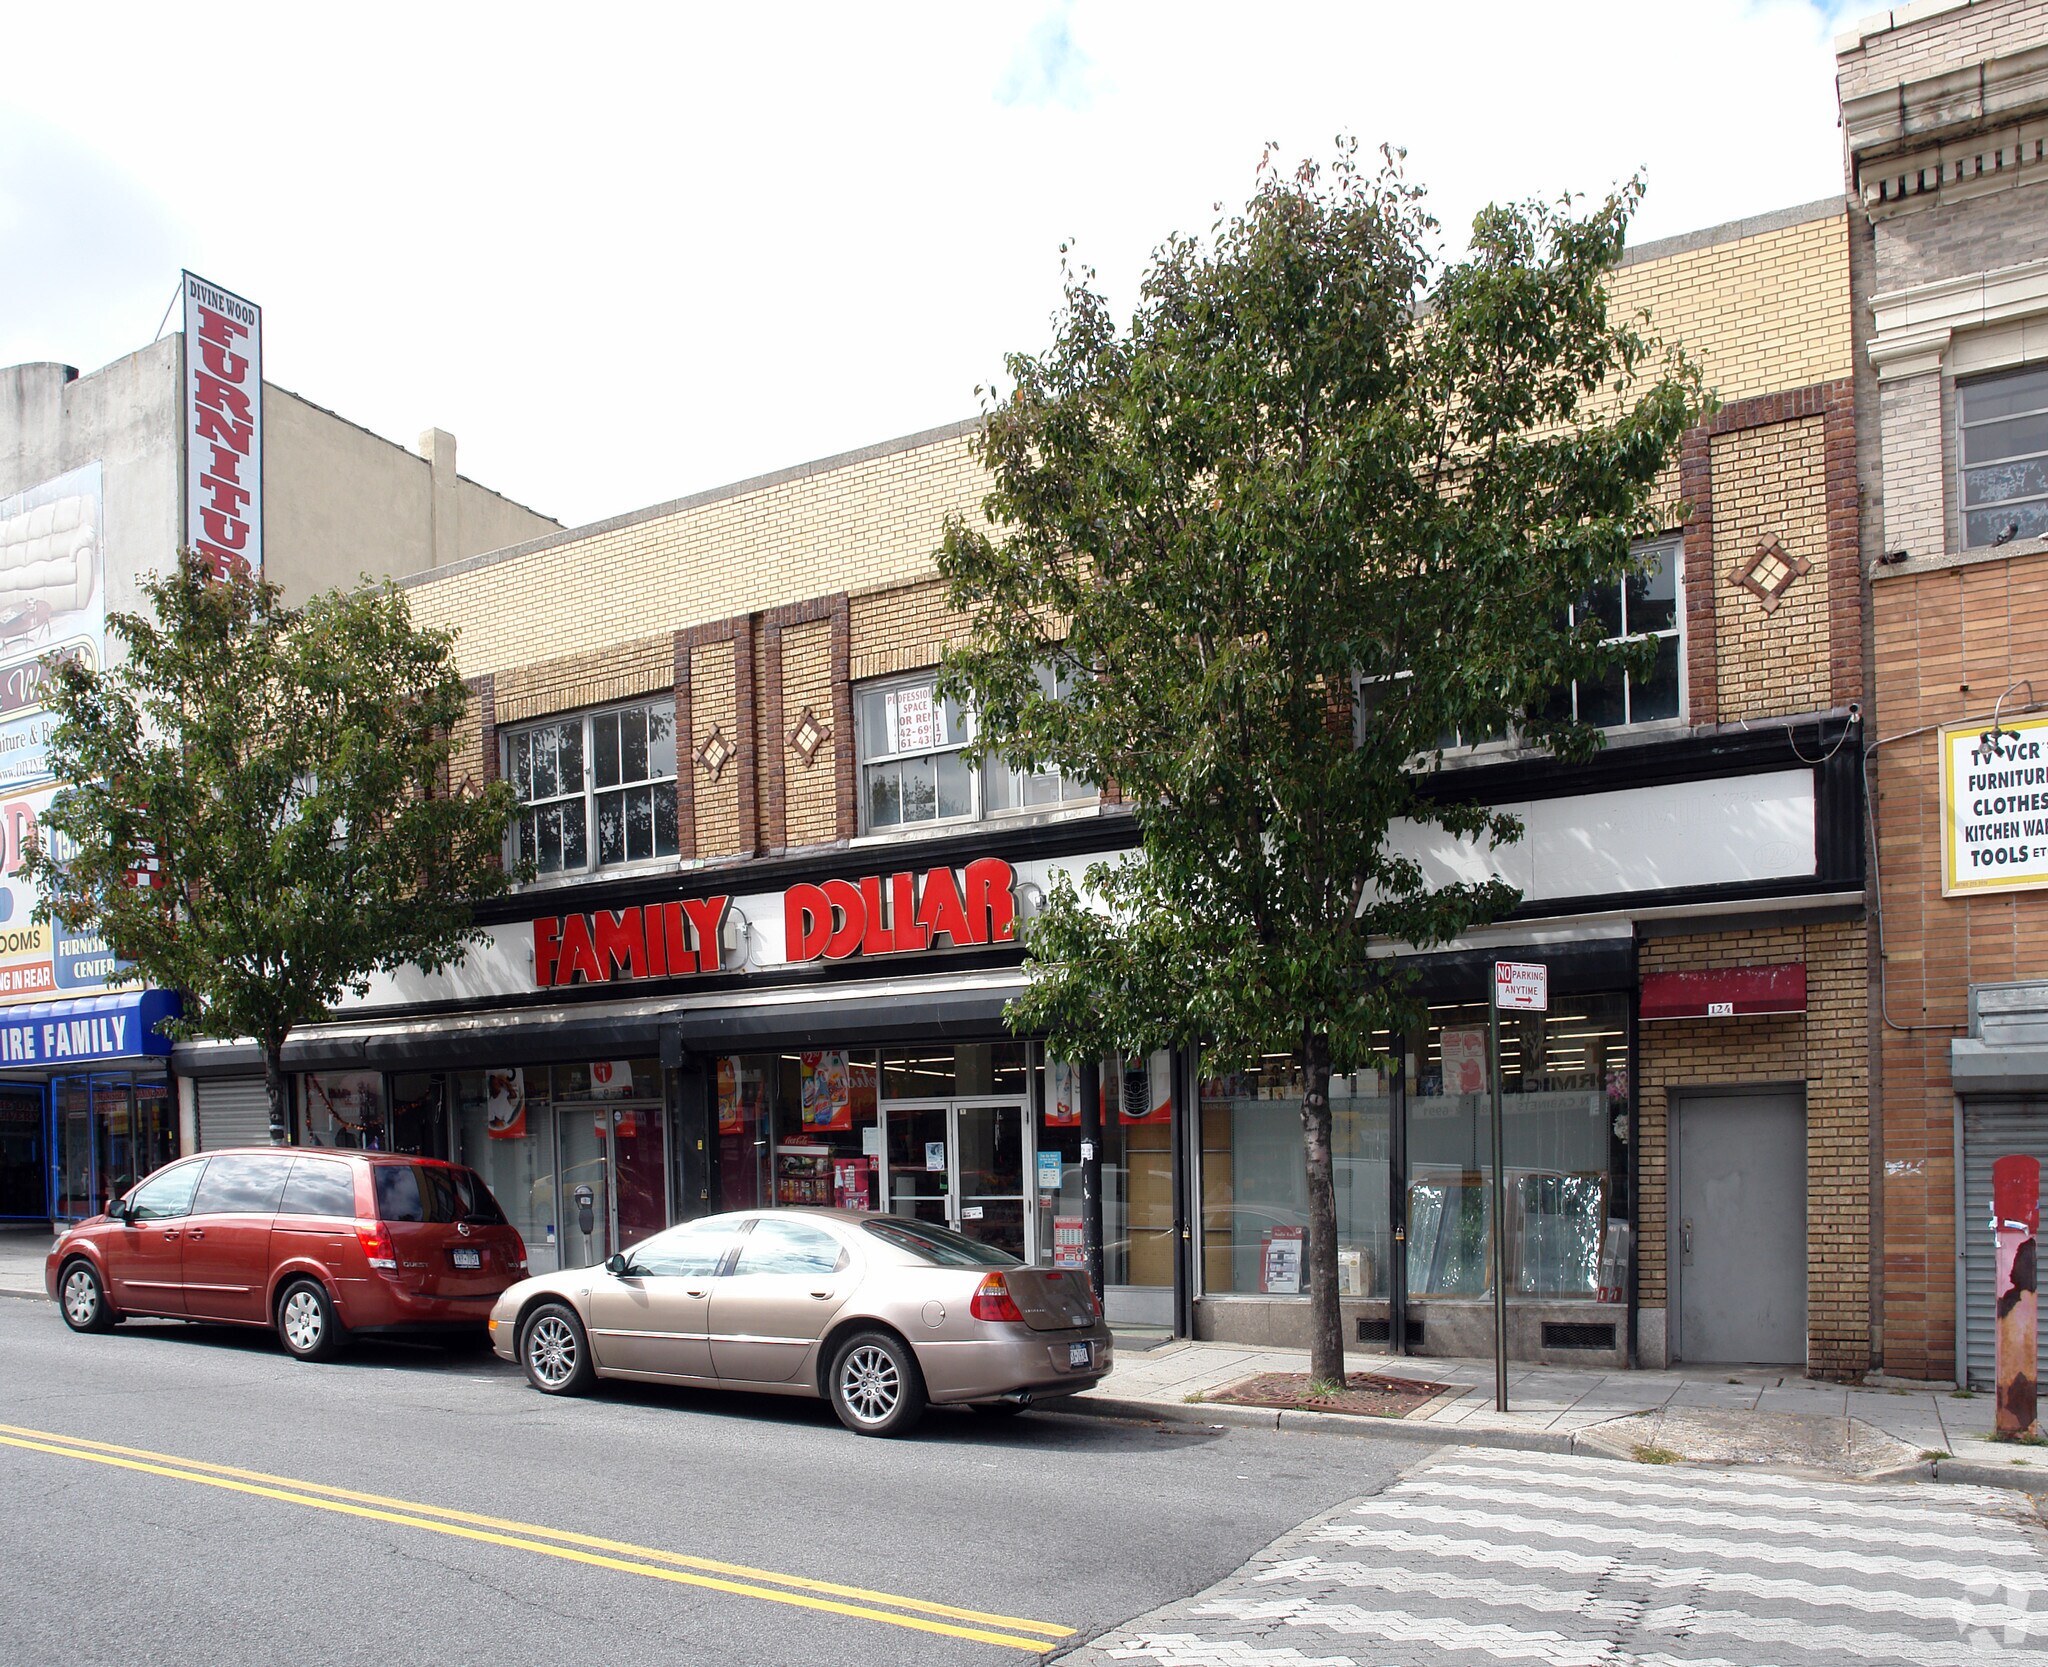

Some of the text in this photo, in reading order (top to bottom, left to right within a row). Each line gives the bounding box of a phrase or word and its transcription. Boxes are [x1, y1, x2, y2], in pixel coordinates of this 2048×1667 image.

[190, 280, 255, 326] DIVINE WOOD
[195, 304, 254, 592] FURNITUR
[903, 701, 927, 713] SPACE
[899, 716, 912, 726] OR
[30, 724, 38, 745] &
[1969, 766, 2048, 792] FURNITUR
[1965, 821, 2019, 842] KITCHEN
[1971, 846, 2048, 867] TOOLS ET
[533, 857, 1015, 987] FAMILY DOLLAR
[12, 970, 22, 990] IN
[24, 967, 51, 988] REAR
[74, 958, 115, 979] CENTER
[1498, 965, 1544, 981] NO PARKING
[1505, 985, 1538, 996] ANYTIME
[1711, 1004, 1731, 1014] 124
[1, 1014, 126, 1061] IRE FAMILY
